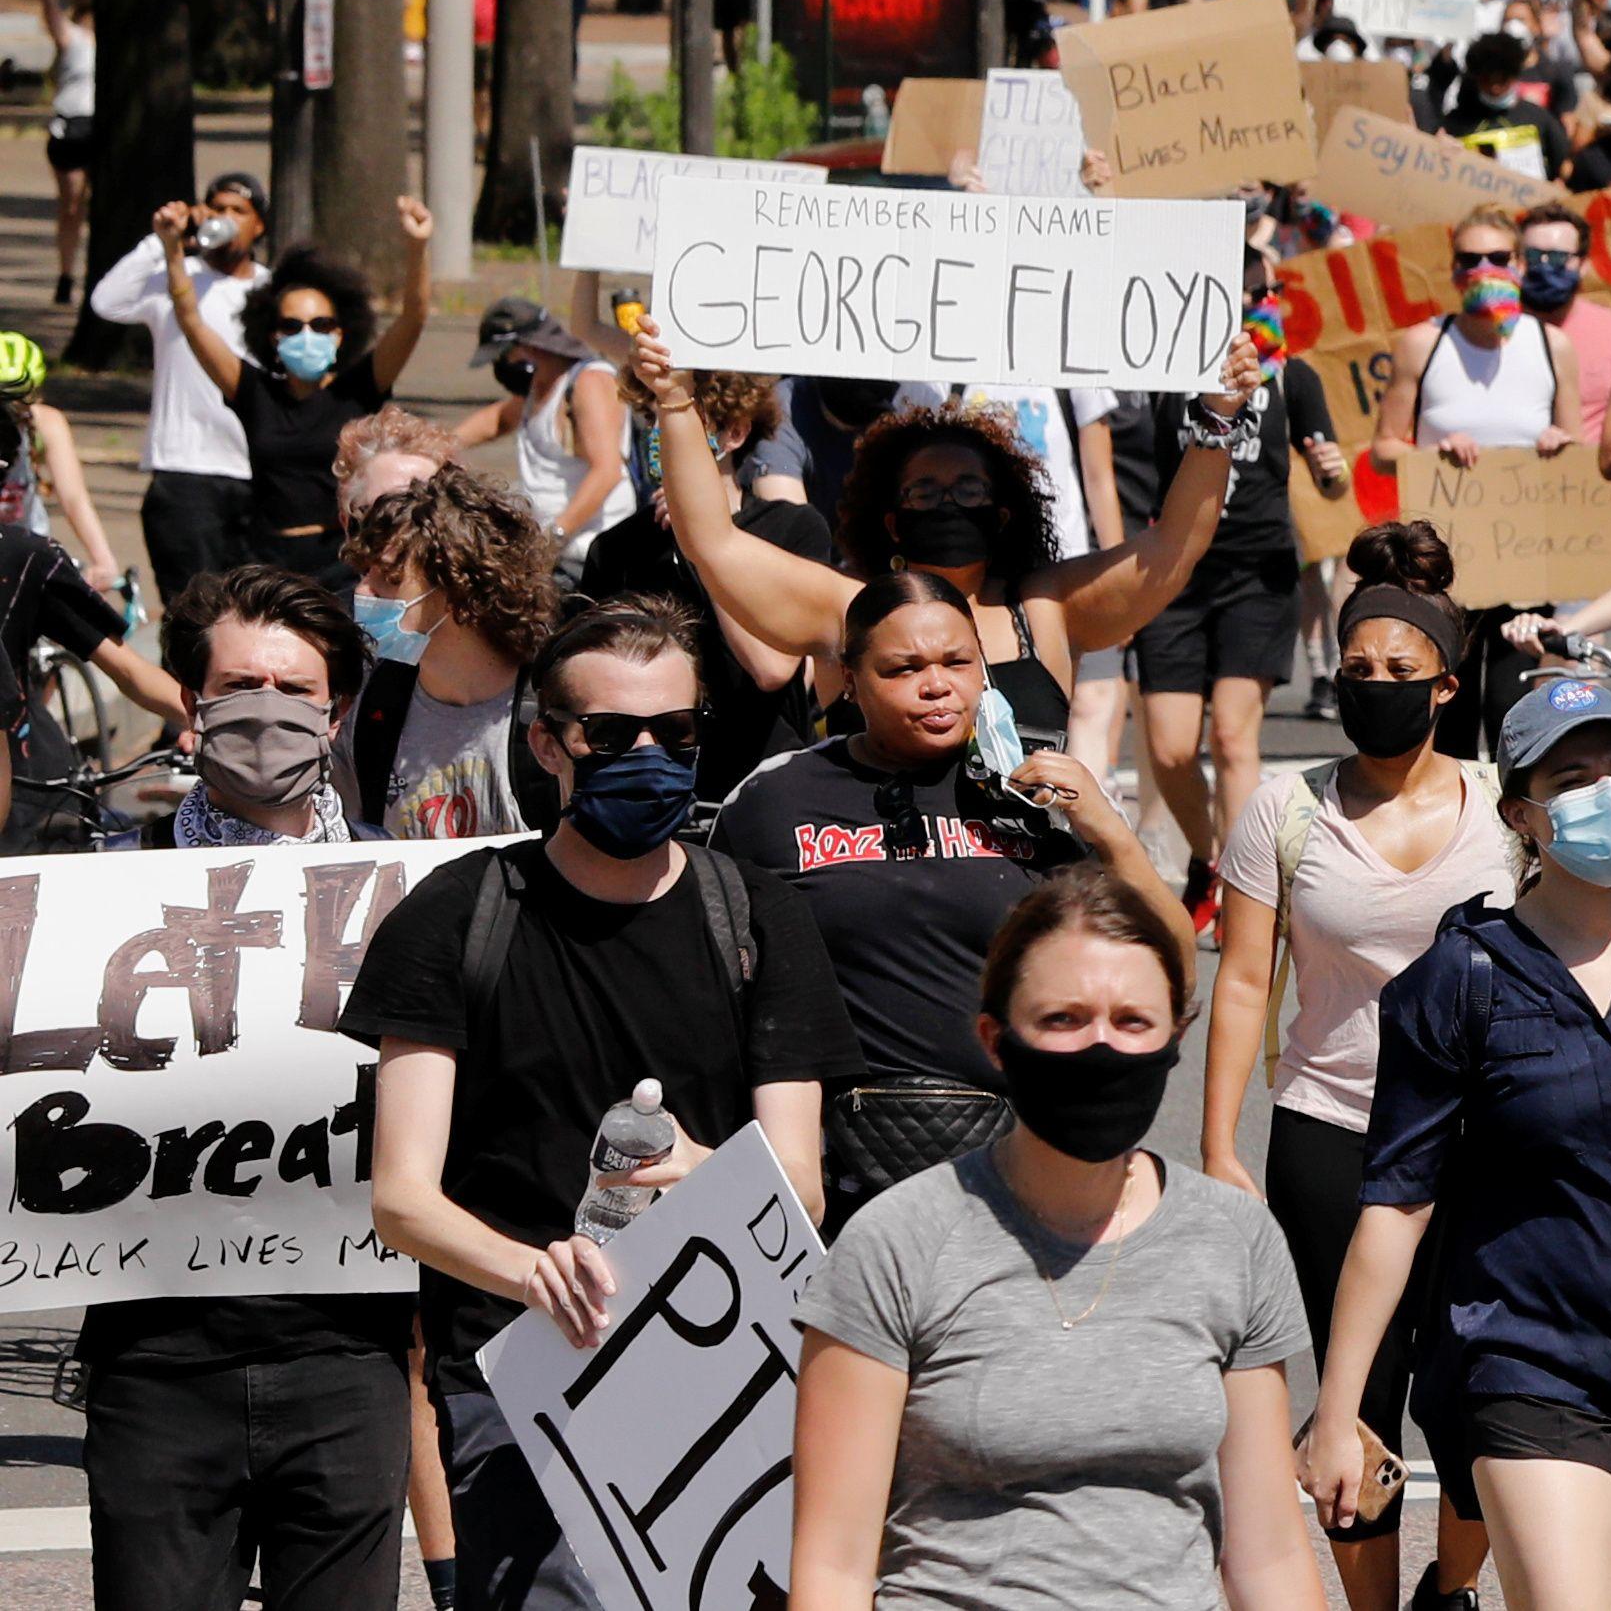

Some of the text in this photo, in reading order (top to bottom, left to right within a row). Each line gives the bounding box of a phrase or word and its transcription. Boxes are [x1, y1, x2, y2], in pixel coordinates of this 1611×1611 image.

[1109, 60, 1224, 111] Black
[1199, 115, 1300, 154] MATTER
[1344, 119, 1537, 206] Say his name
[755, 190, 1113, 238] REMEMBER HIS NAME
[668, 241, 1234, 376] GEORGE FLOYD
[1429, 467, 1485, 509] No
[1498, 523, 1605, 559] Peace
[1555, 686, 1597, 708] NASA
[794, 822, 887, 873] BOYZ
[188, 1234, 305, 1272] LIVES
